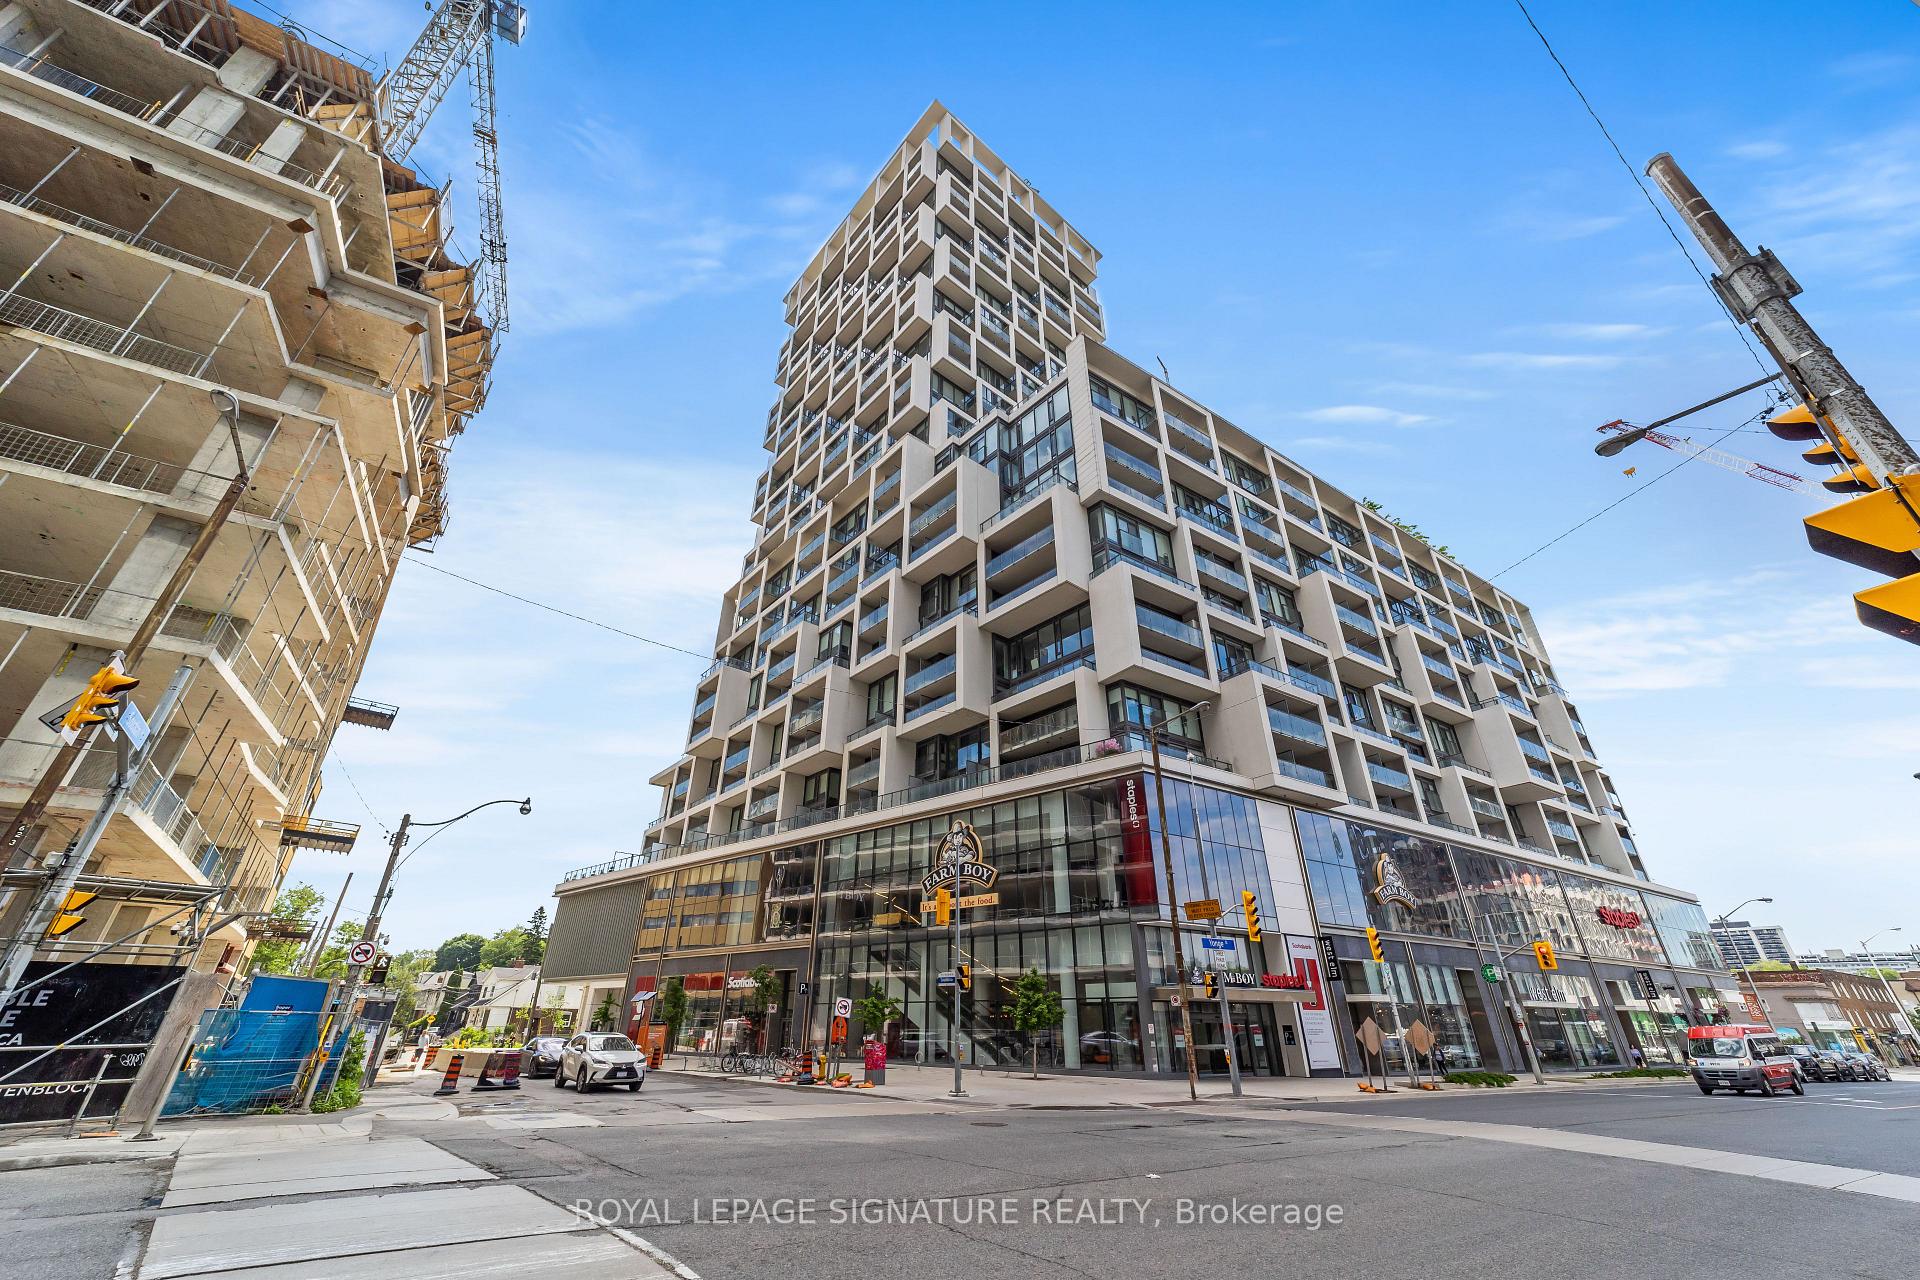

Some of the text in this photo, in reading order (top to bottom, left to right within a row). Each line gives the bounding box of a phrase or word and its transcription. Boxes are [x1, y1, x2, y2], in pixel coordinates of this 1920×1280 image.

[1126, 779, 1138, 821] staples
[923, 863, 992, 890] FARM BOY
[964, 898, 975, 907] the
[977, 895, 995, 905] food.
[1208, 939, 1224, 949] Yonge
[1325, 939, 1338, 978] west elm
[727, 976, 761, 989] Scotiab
[1235, 972, 1256, 985] BOY
[1262, 973, 1300, 989] staples
